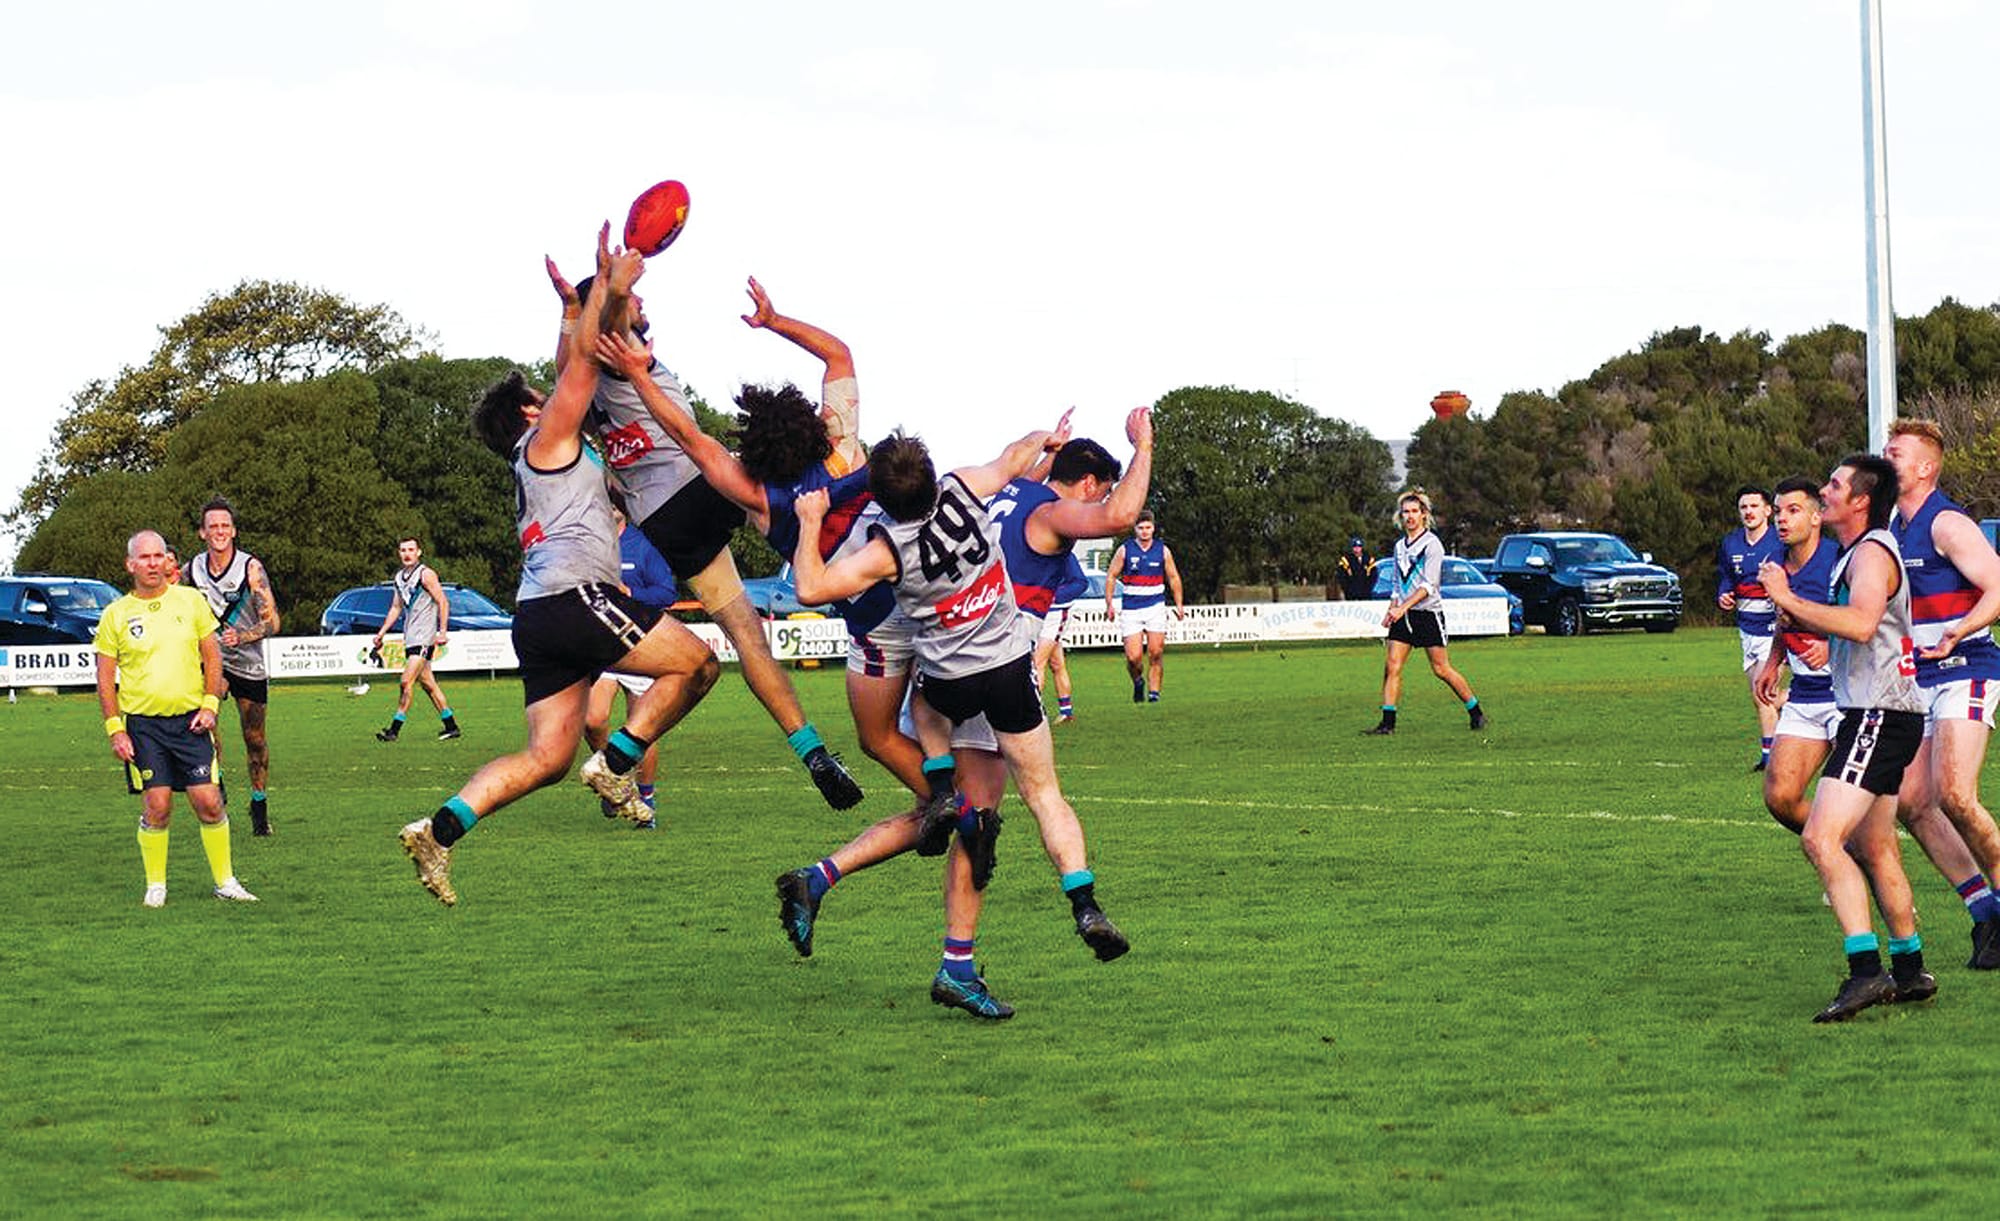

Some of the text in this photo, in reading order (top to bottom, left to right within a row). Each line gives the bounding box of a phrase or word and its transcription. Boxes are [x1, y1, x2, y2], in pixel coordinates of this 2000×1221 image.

[919, 490, 989, 584] 49
[1263, 606, 1316, 628] FOSTER
[799, 640, 834, 654] 0400
[15, 652, 70, 669] BRAD
